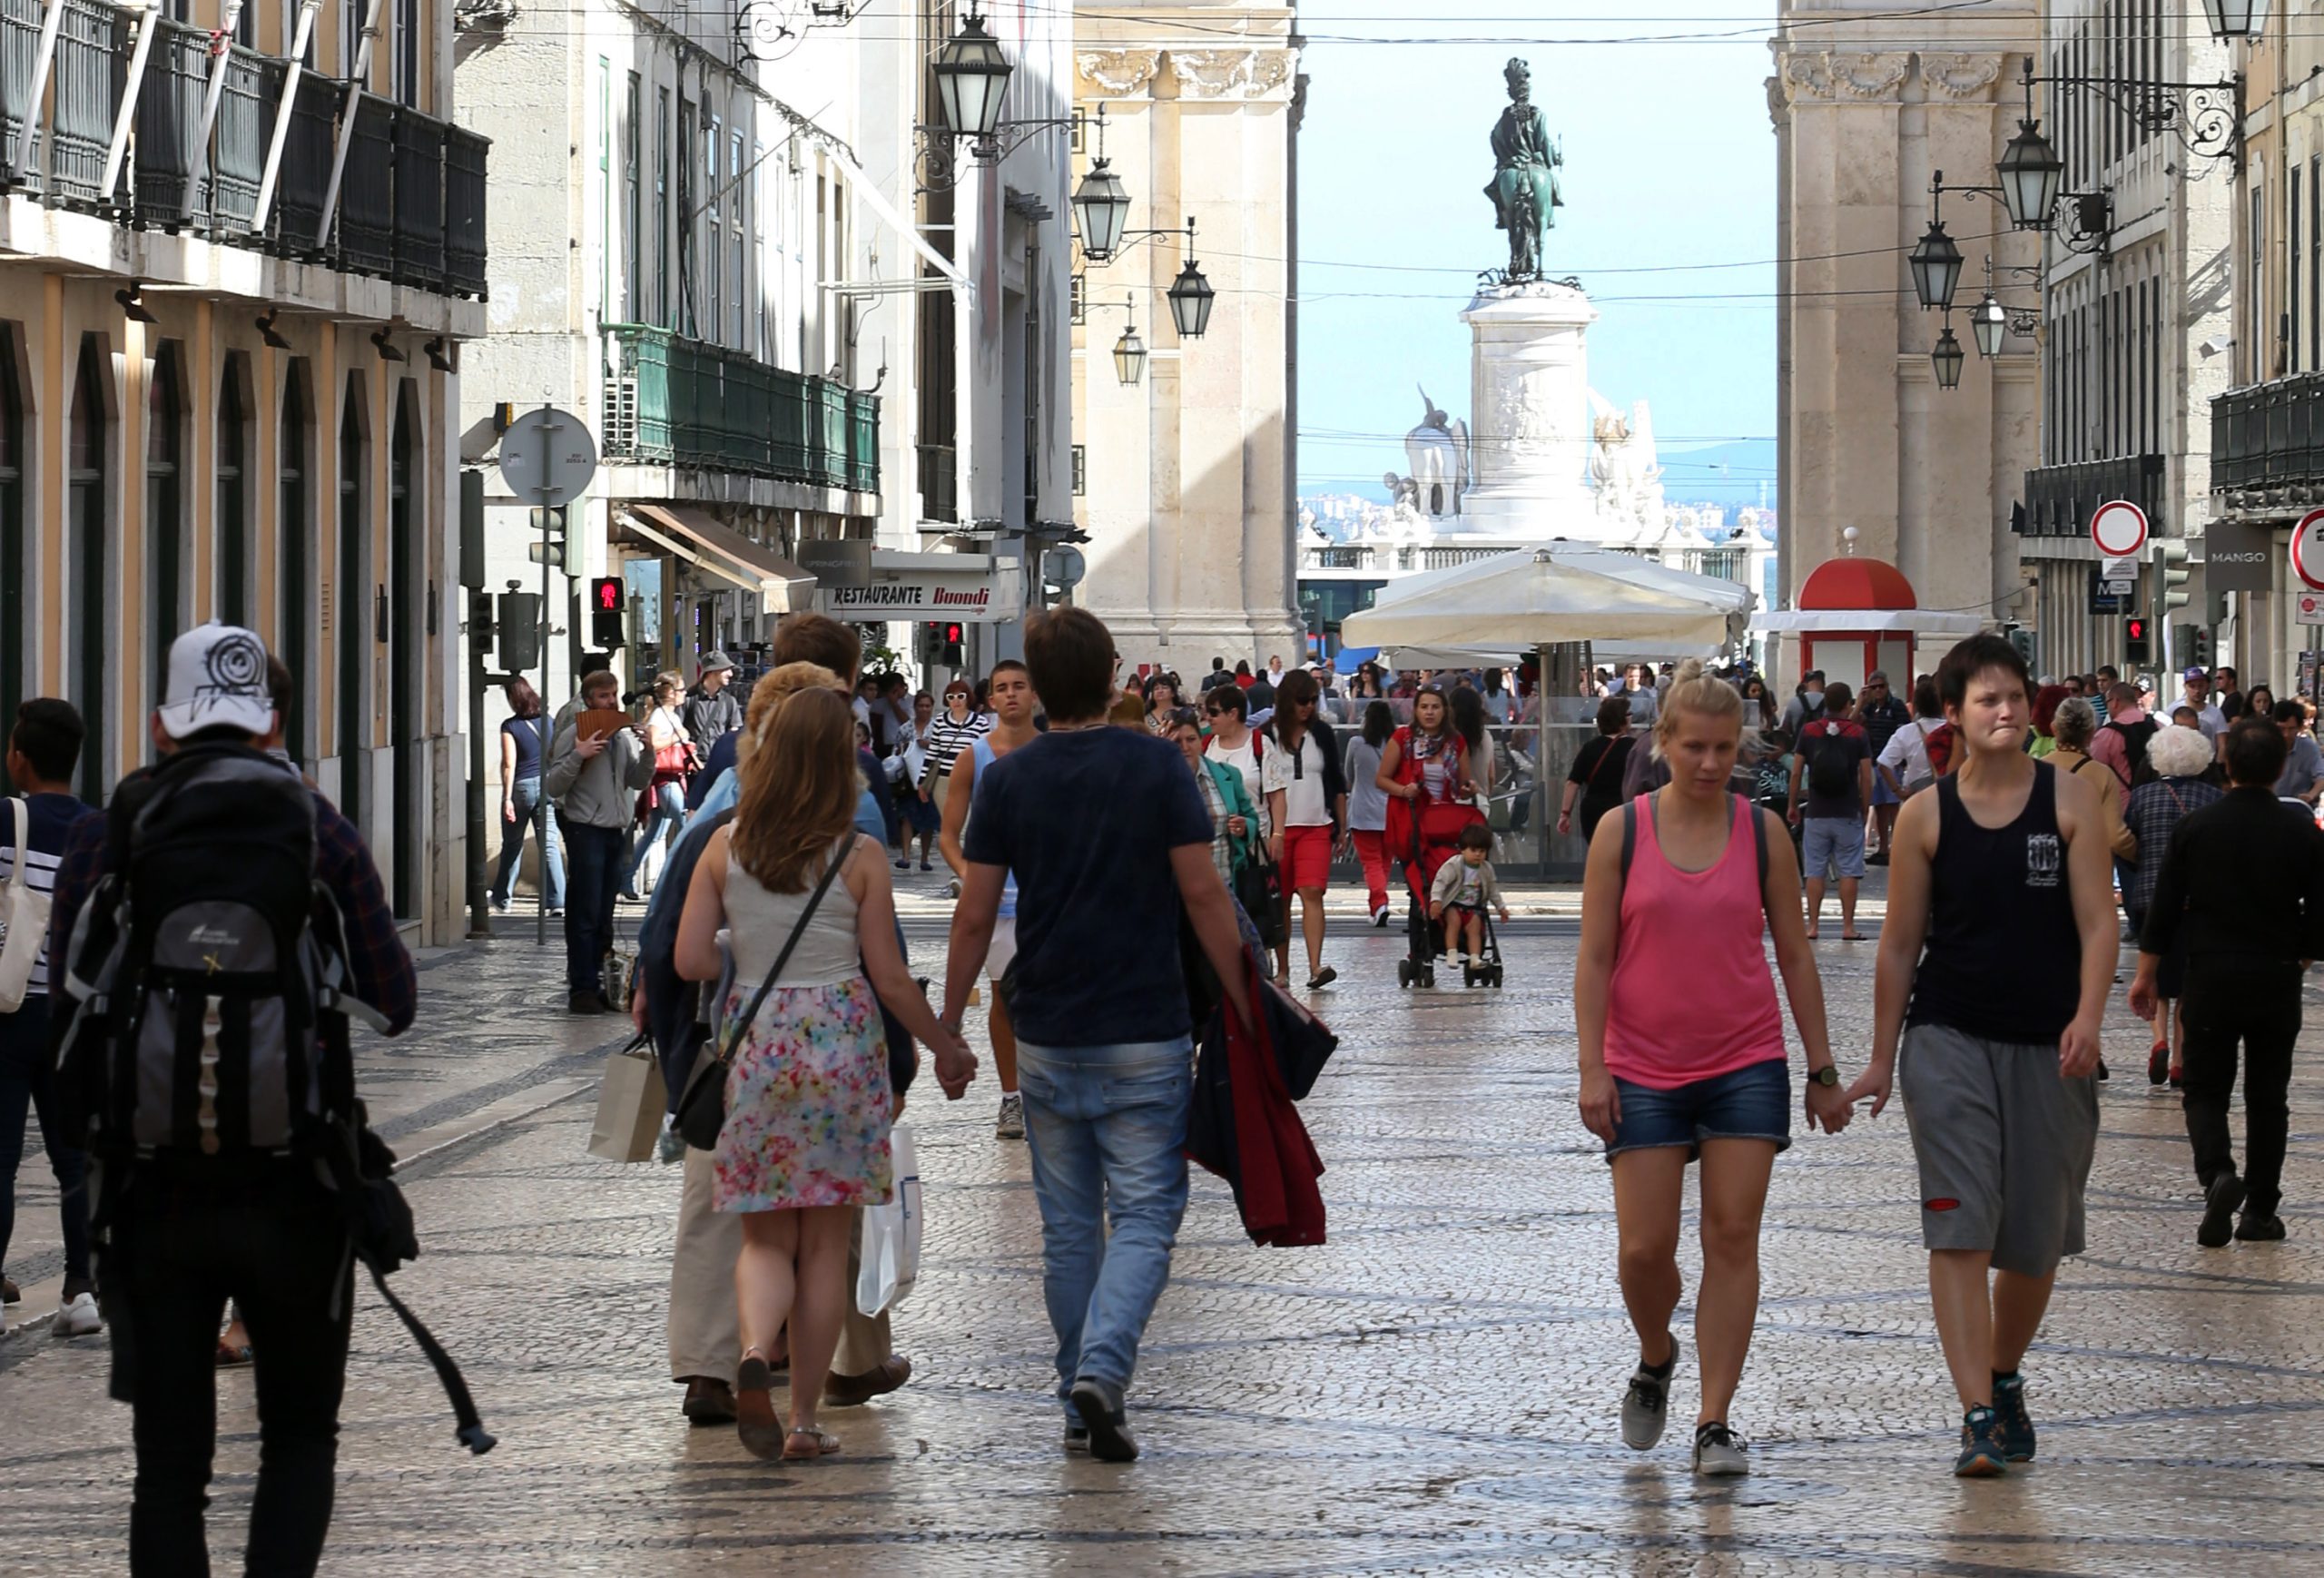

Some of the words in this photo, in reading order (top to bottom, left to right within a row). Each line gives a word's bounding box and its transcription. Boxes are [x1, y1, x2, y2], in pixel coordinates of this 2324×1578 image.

[2211, 552, 2267, 563] MANGO
[834, 587, 923, 606] RESTAURANTE
[932, 587, 990, 607] Buondi
